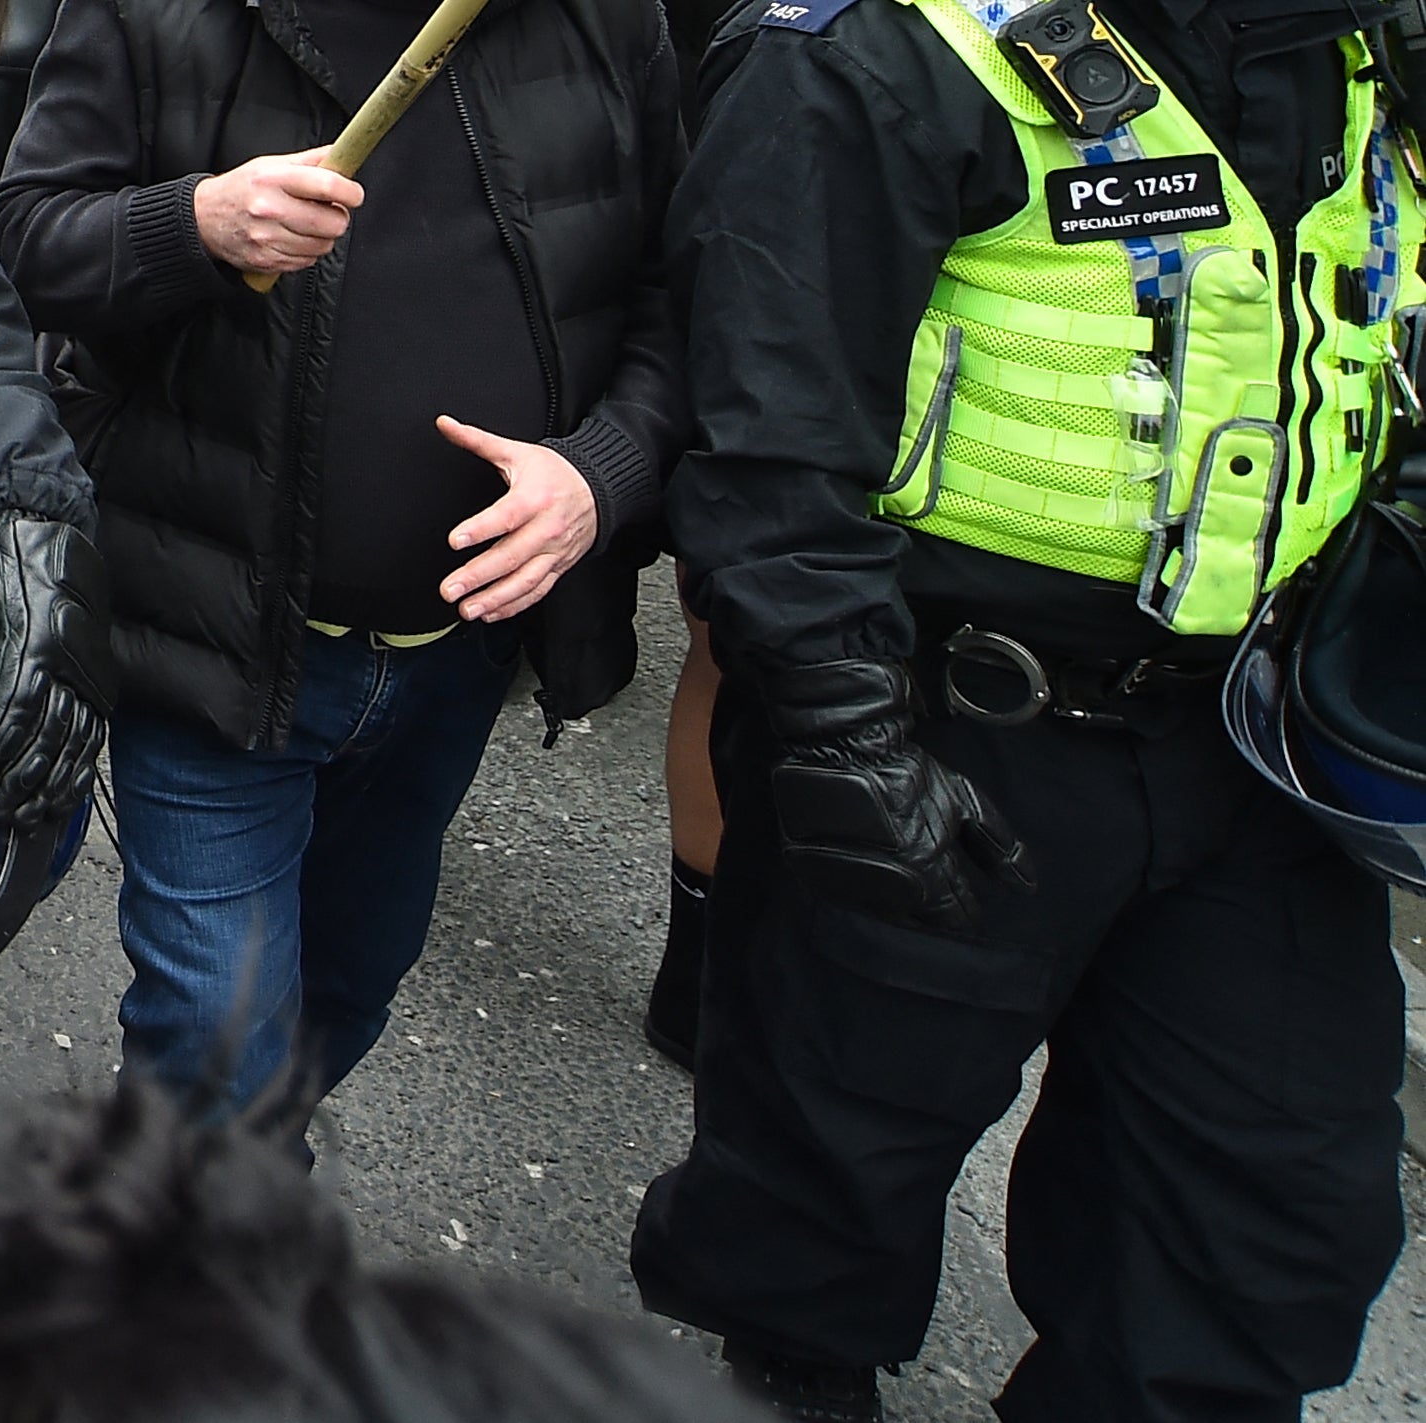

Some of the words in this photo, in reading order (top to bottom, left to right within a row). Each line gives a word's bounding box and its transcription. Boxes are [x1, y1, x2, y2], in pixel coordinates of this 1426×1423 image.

[764, 2, 810, 21] 7457
[1069, 178, 1123, 210] PC
[1134, 173, 1198, 198] 17457
[1061, 213, 1141, 232] SPECIALIST
[1142, 204, 1220, 224] OPERATIONS
